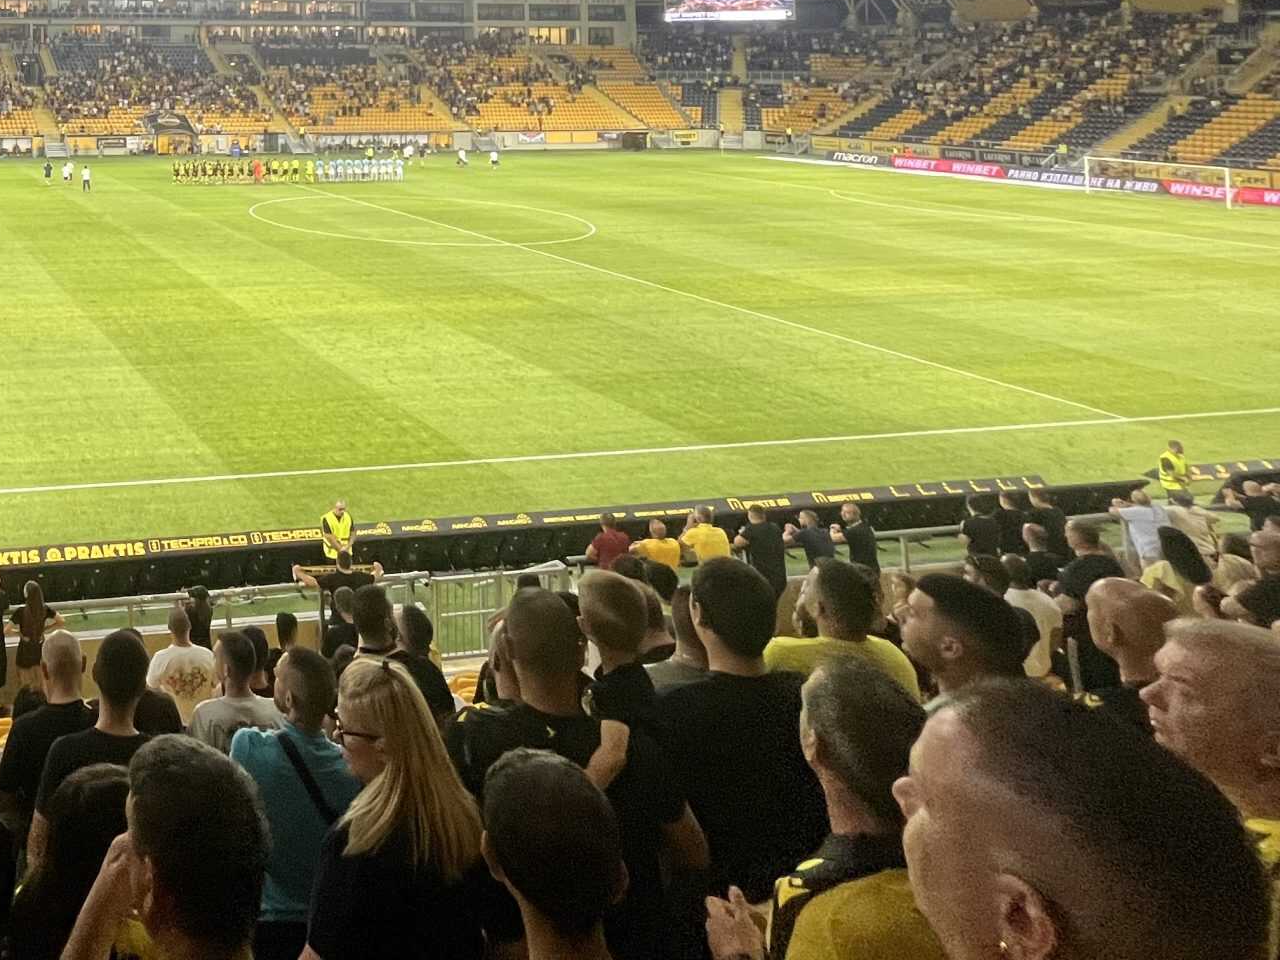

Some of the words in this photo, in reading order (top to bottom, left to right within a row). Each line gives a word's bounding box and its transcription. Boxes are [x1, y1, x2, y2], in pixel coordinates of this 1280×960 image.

[832, 151, 878, 165] macron
[894, 156, 937, 170] WINBET
[951, 162, 999, 176] WINBET
[63, 542, 146, 561] PRAKTIS
